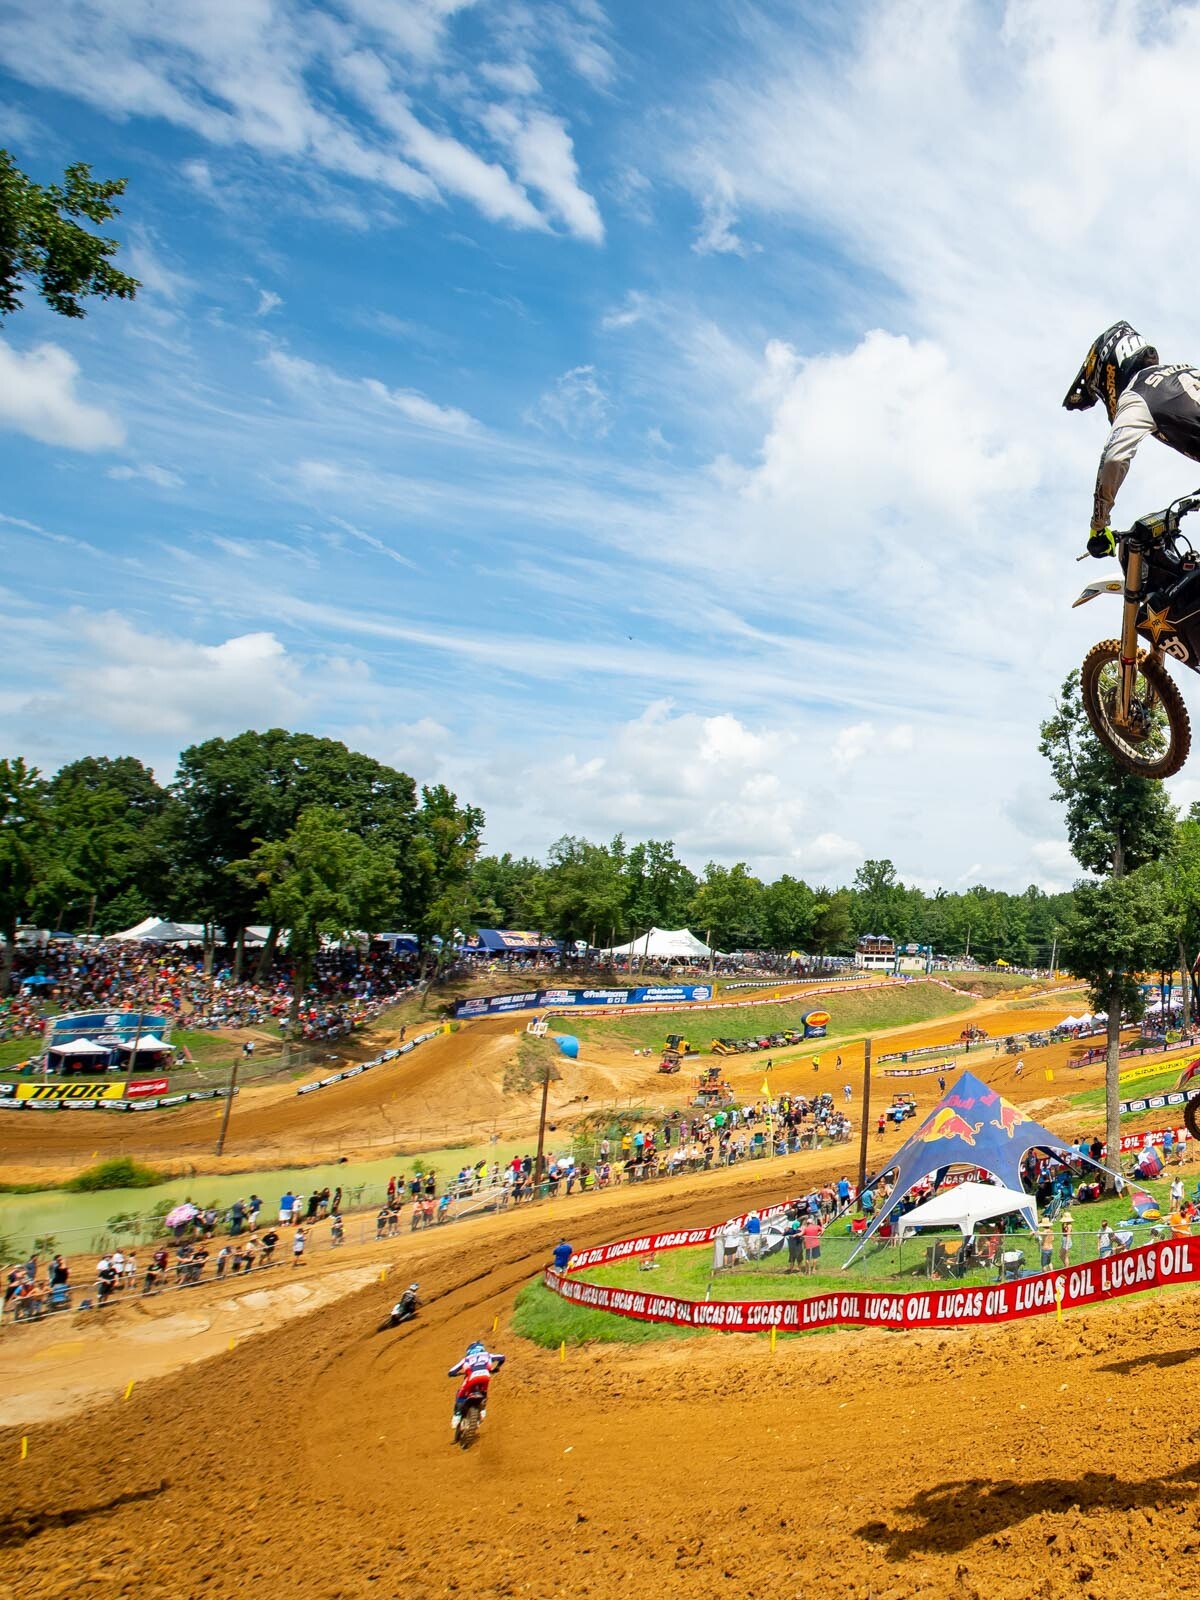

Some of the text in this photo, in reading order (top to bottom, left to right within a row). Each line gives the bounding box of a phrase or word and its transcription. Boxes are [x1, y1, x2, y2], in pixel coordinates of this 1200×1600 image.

[31, 1084, 110, 1098] THOR
[1124, 1136, 1139, 1149] OIL
[941, 1174, 965, 1185] UCAS
[588, 1250, 605, 1264] OIL
[606, 1243, 634, 1259] LUCAS
[634, 1238, 650, 1252] OIL
[654, 1232, 687, 1247] LUCAS
[688, 1230, 707, 1242] OIL
[610, 1292, 633, 1310] LUCAS
[633, 1295, 645, 1313] OIL
[647, 1298, 676, 1318] LUCAS
[676, 1303, 691, 1321] OIL
[693, 1305, 725, 1324] LUCAS
[725, 1305, 743, 1324] OIL
[747, 1305, 783, 1324] LUCAS
[783, 1304, 798, 1325] OIL
[803, 1295, 838, 1323] LUCAS
[840, 1296, 860, 1319] OIL
[864, 1298, 904, 1321] LUCAS
[906, 1294, 931, 1320] OIL
[936, 1291, 981, 1319] LUCAS
[985, 1289, 1008, 1316] OIL
[1015, 1275, 1065, 1312] LUCAS
[1069, 1268, 1095, 1299] OIL
[1101, 1251, 1156, 1292] LUCAS
[1160, 1244, 1193, 1275] OIL
